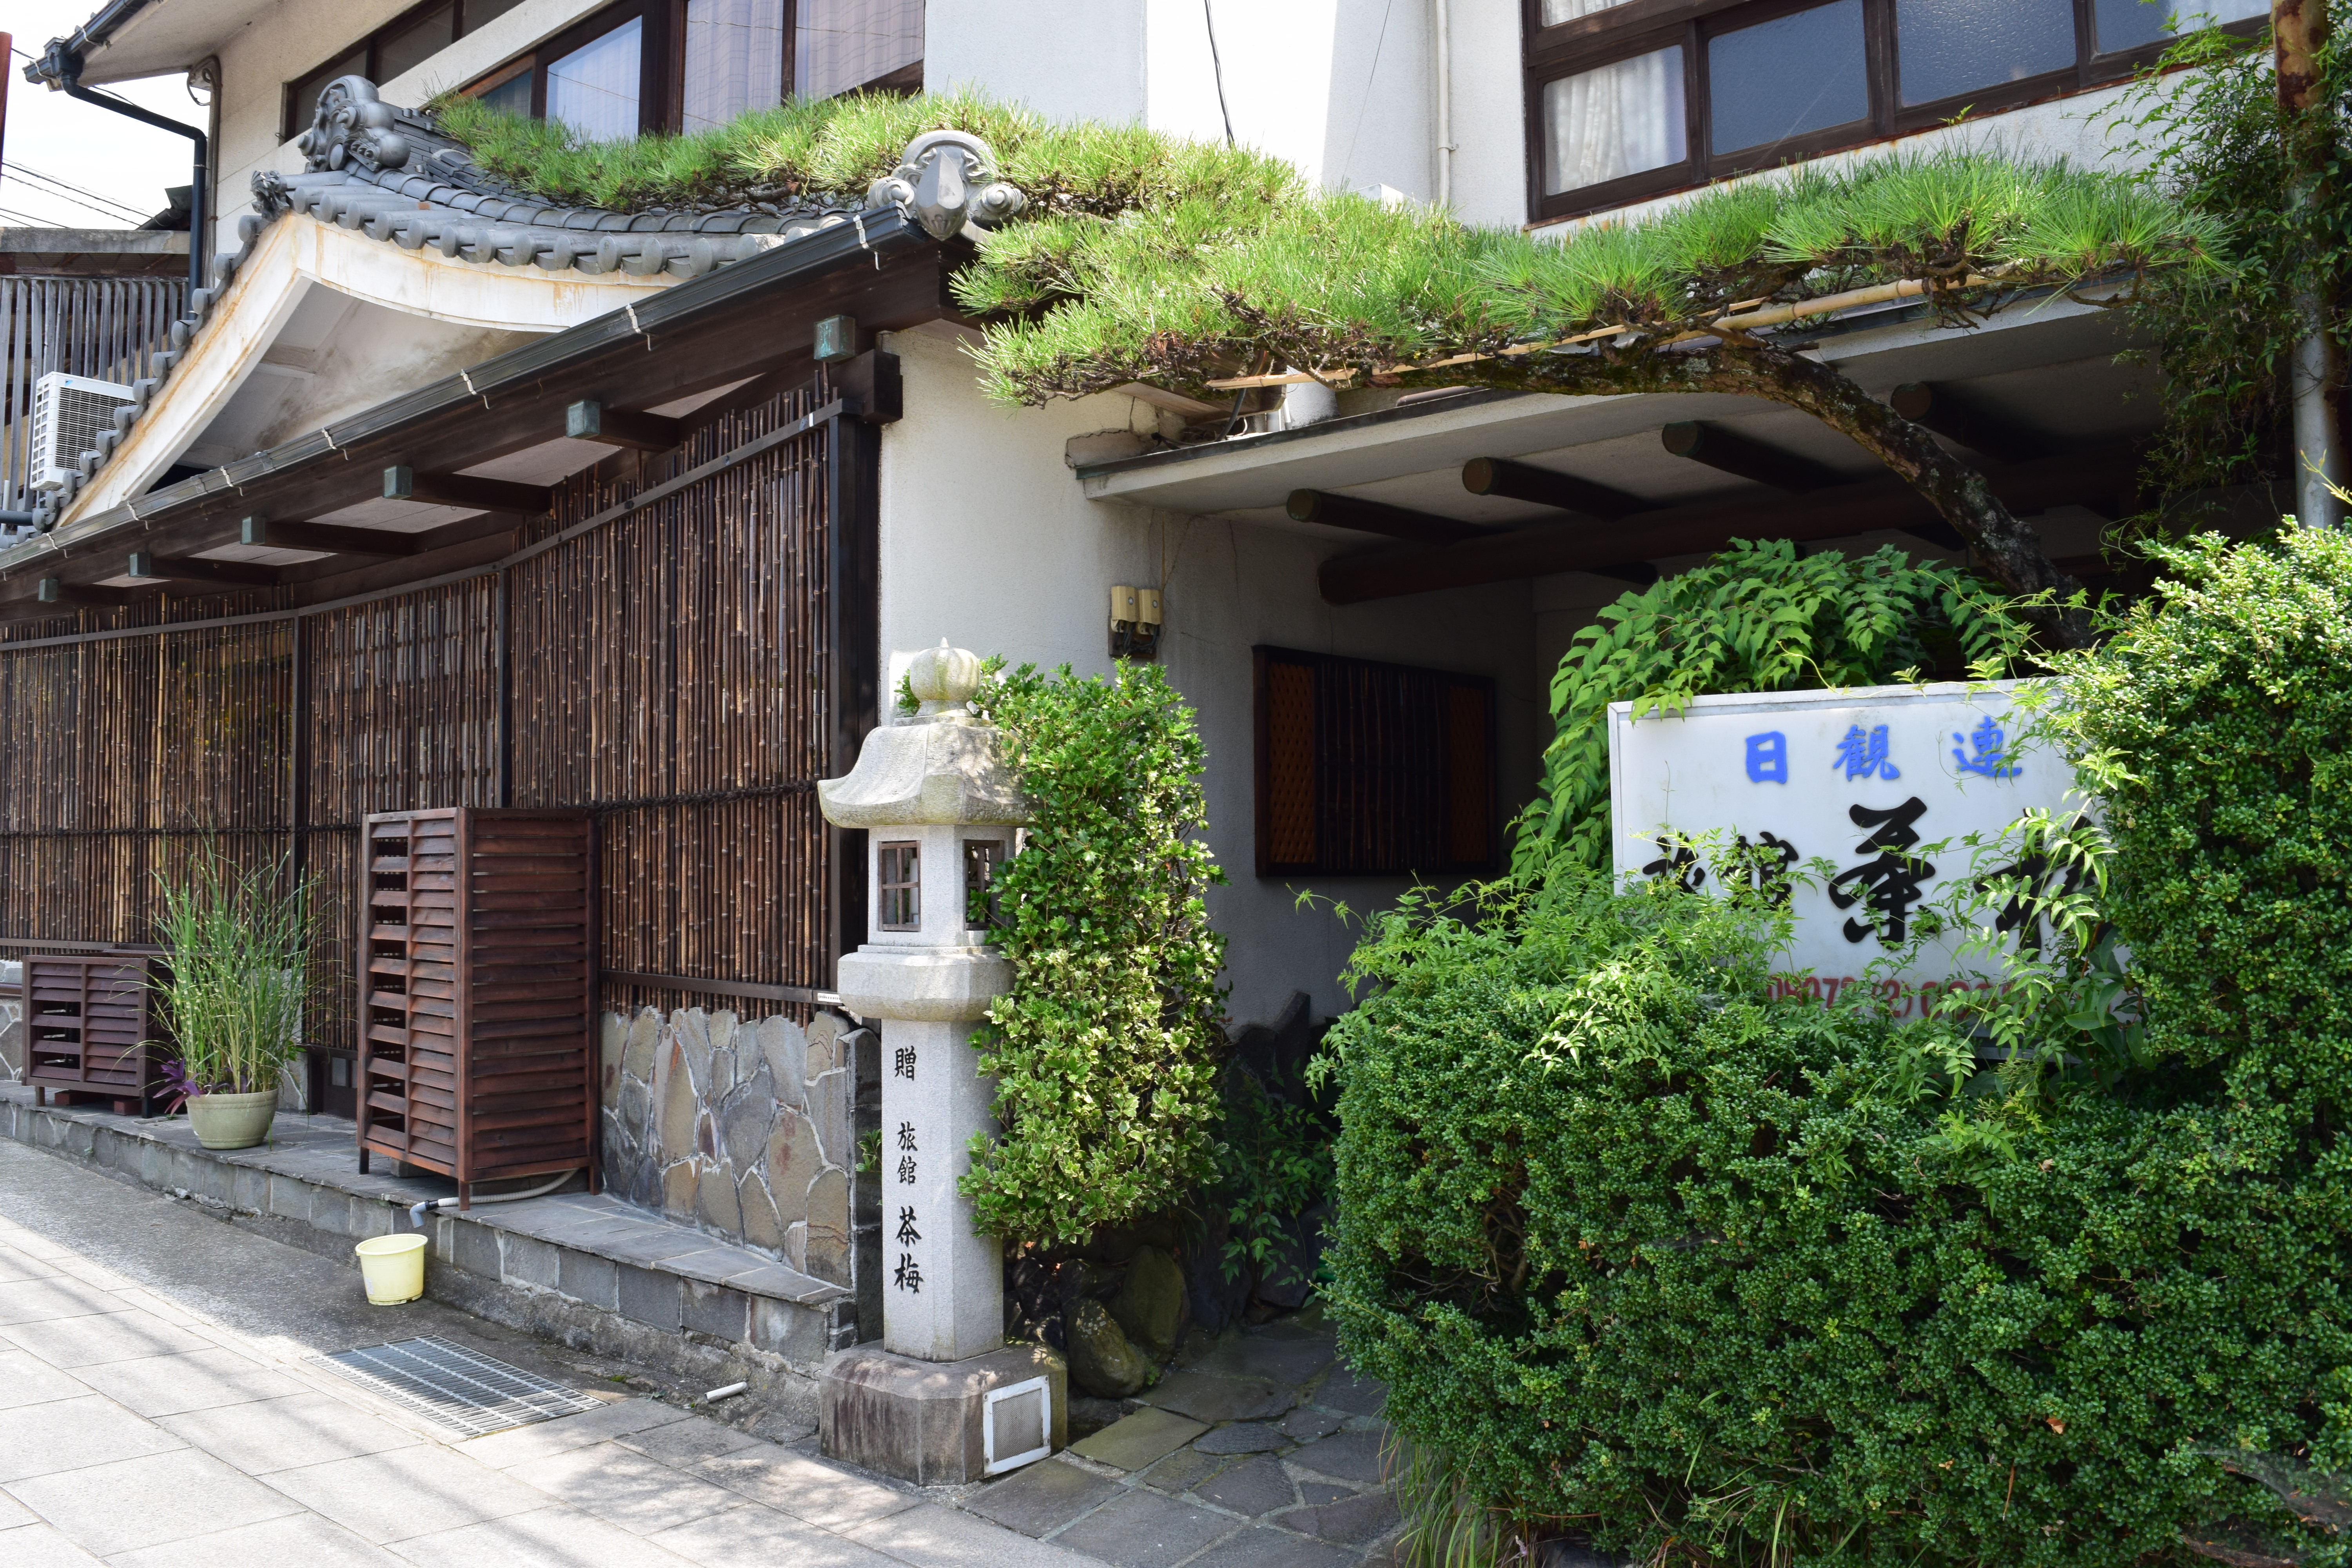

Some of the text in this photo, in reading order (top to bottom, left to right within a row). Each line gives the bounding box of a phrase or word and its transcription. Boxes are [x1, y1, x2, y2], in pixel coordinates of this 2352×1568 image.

[1745, 715, 2022, 784] 日観連
[894, 1045, 924, 1294] 贈 旅館 茶梅
